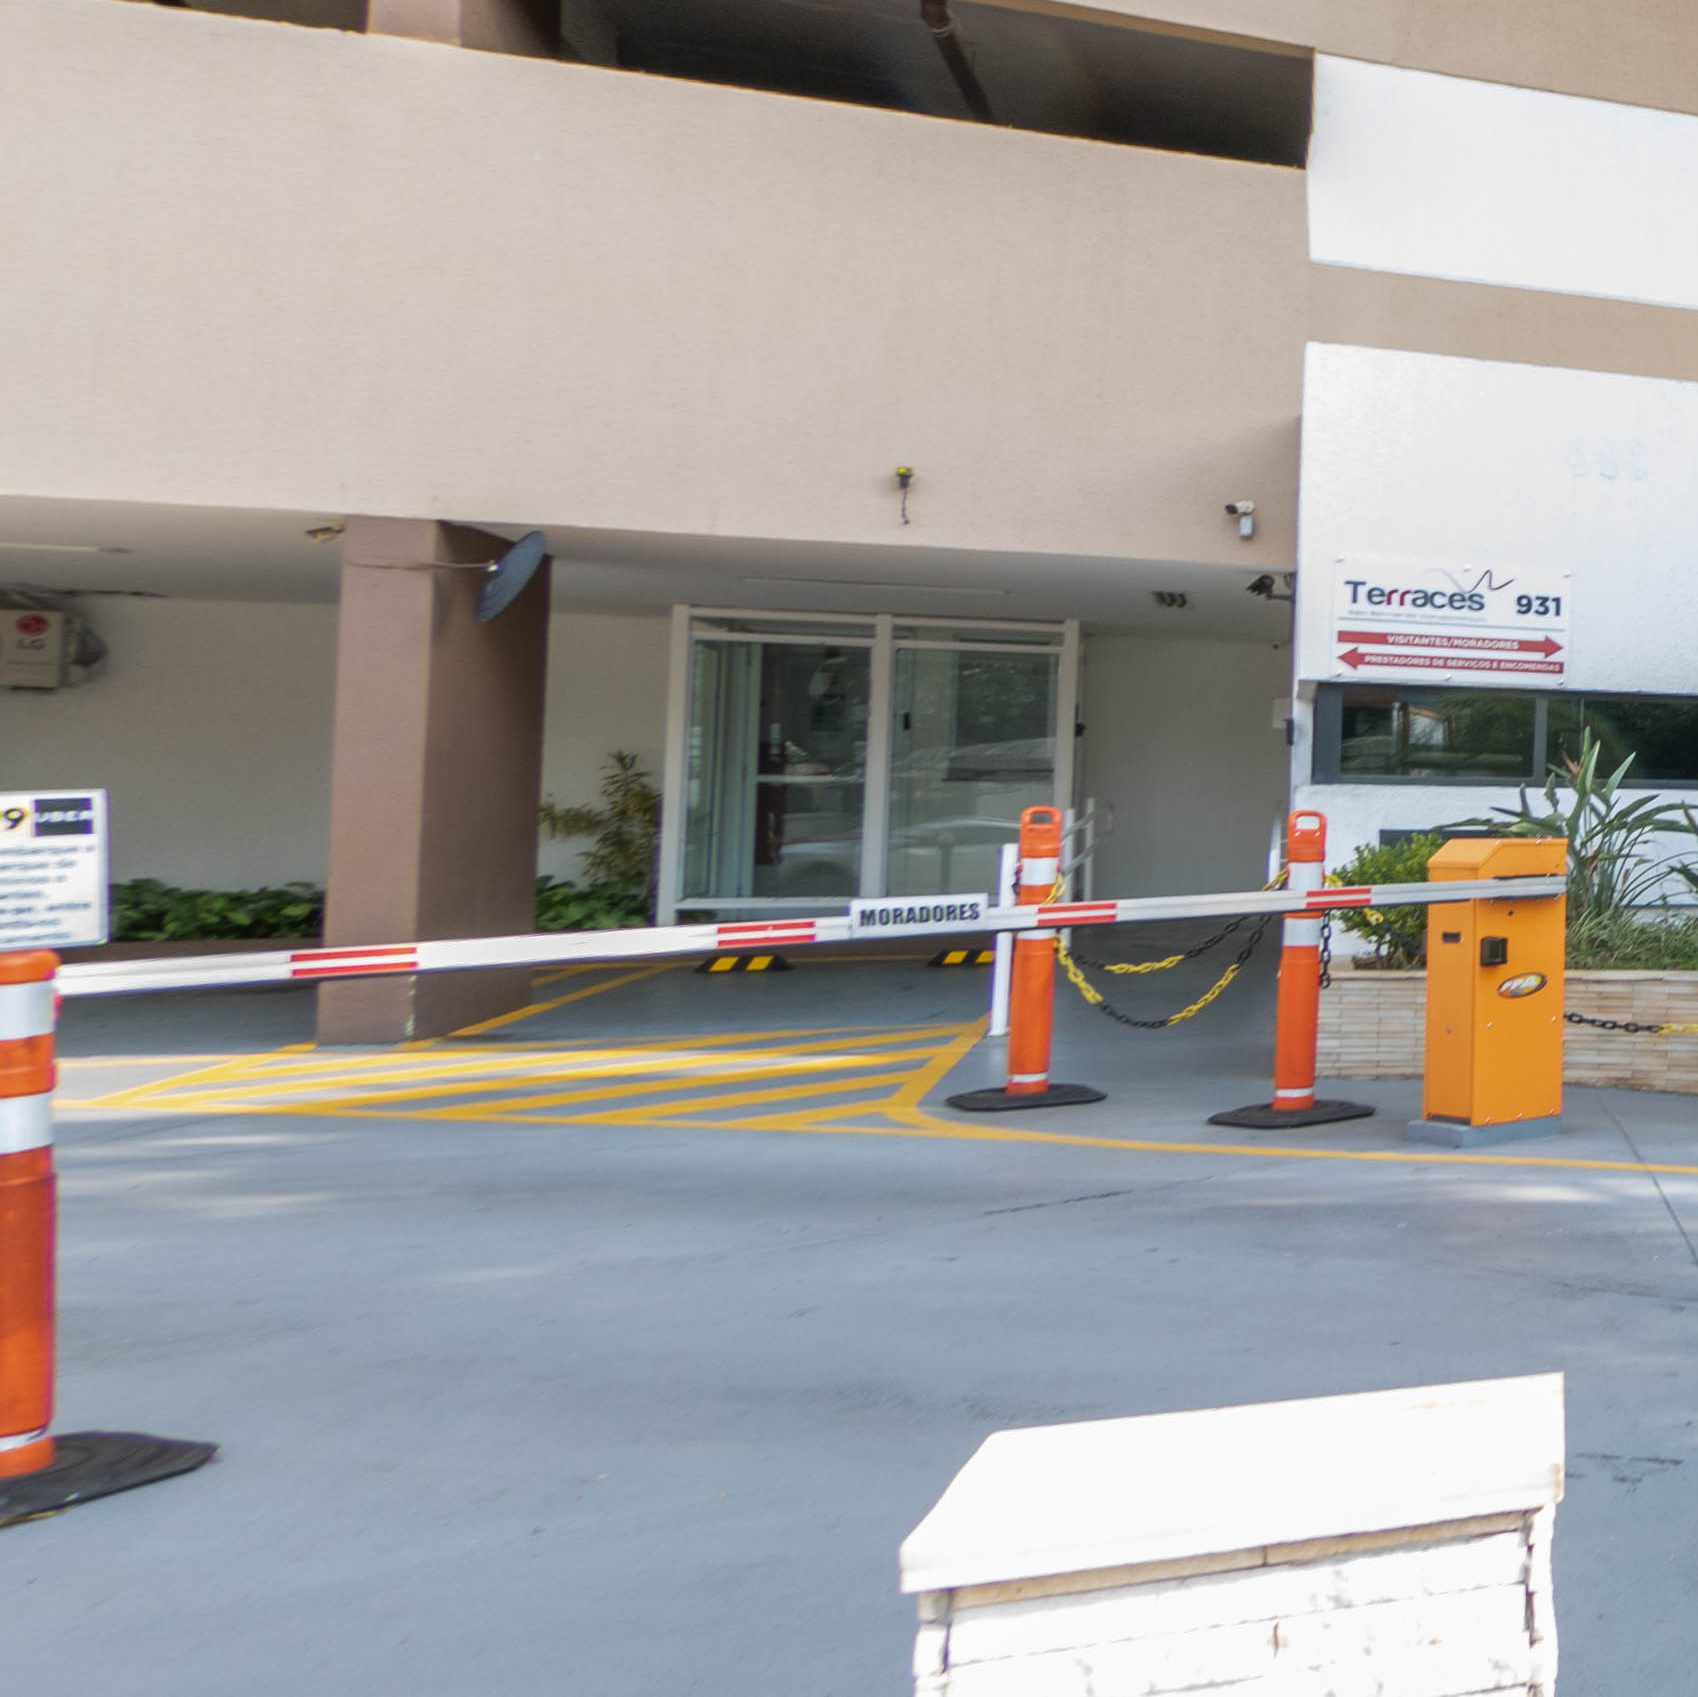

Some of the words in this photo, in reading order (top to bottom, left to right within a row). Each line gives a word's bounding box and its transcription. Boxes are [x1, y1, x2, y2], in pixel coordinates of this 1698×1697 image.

[1344, 580, 1486, 612] Terraces
[1516, 594, 1562, 617] 931
[1386, 634, 1519, 651] VISITANTES/MORADORES
[1364, 654, 1431, 667] PRESTADORES
[1432, 658, 1445, 668] DE
[1499, 661, 1561, 673] ENCOMENDAS
[859, 902, 980, 927] MORADORES
